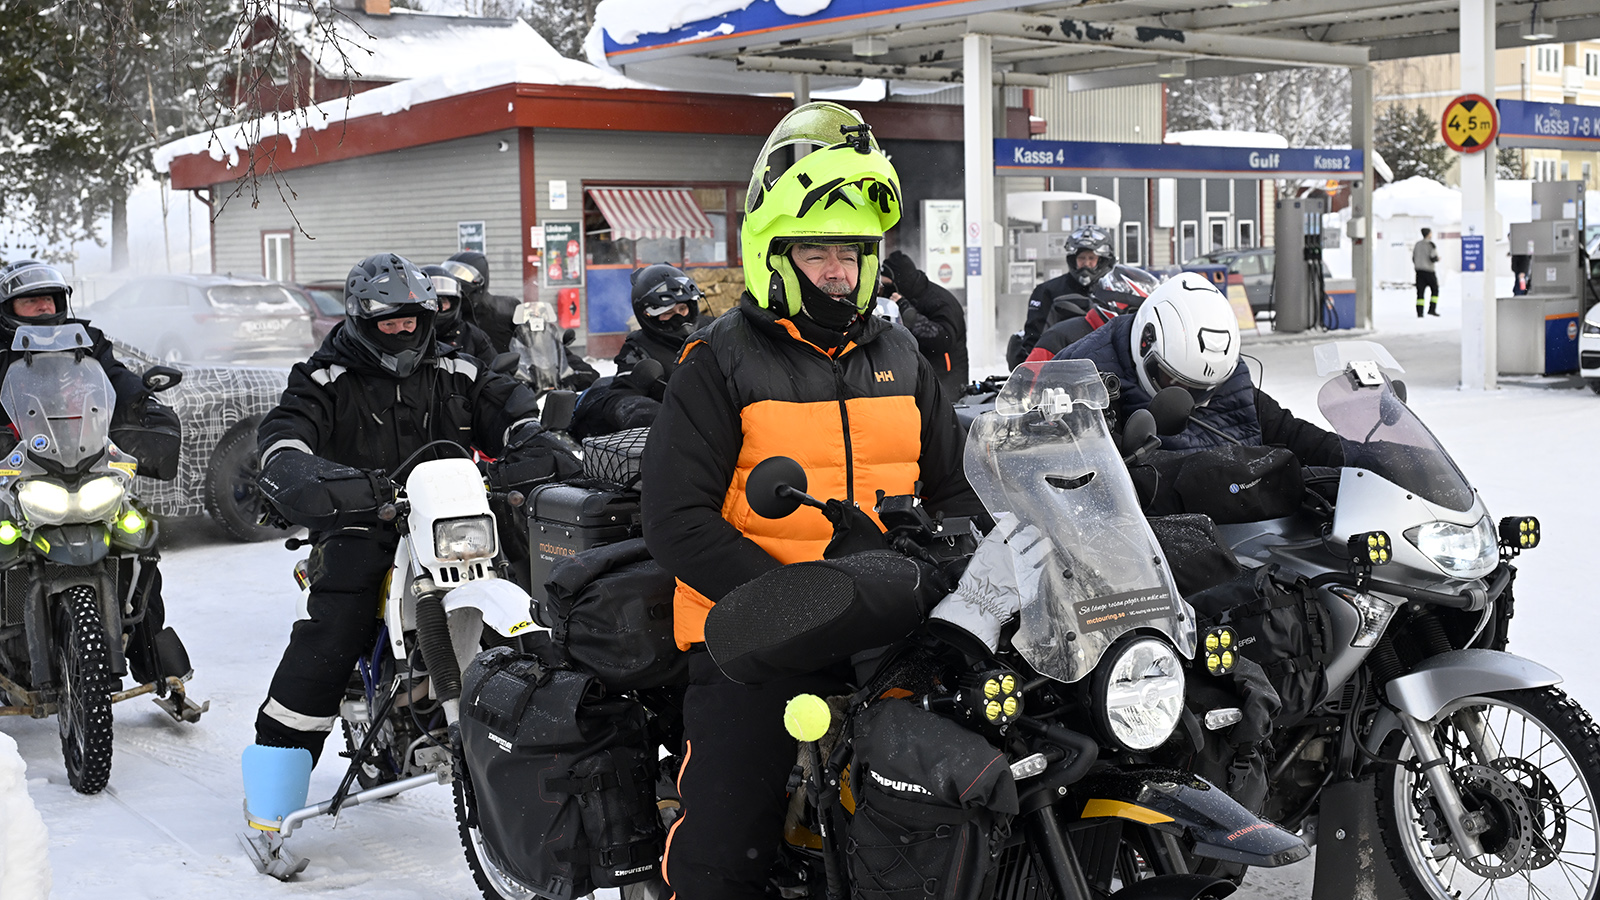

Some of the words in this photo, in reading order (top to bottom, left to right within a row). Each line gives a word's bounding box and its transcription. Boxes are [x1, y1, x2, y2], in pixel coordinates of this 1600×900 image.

[1448, 114, 1478, 133] 4,5
[1480, 119, 1491, 130] m
[1535, 113, 1569, 135] Kassa
[1572, 117, 1591, 136] 7-8
[1014, 147, 1053, 164] Kassa
[1055, 148, 1065, 164] 4
[1249, 151, 1280, 169] Gulf
[1314, 155, 1343, 169] Kassa
[1343, 155, 1351, 169] 2
[874, 370, 894, 382] HH
[1086, 612, 1126, 625] mctouring.se
